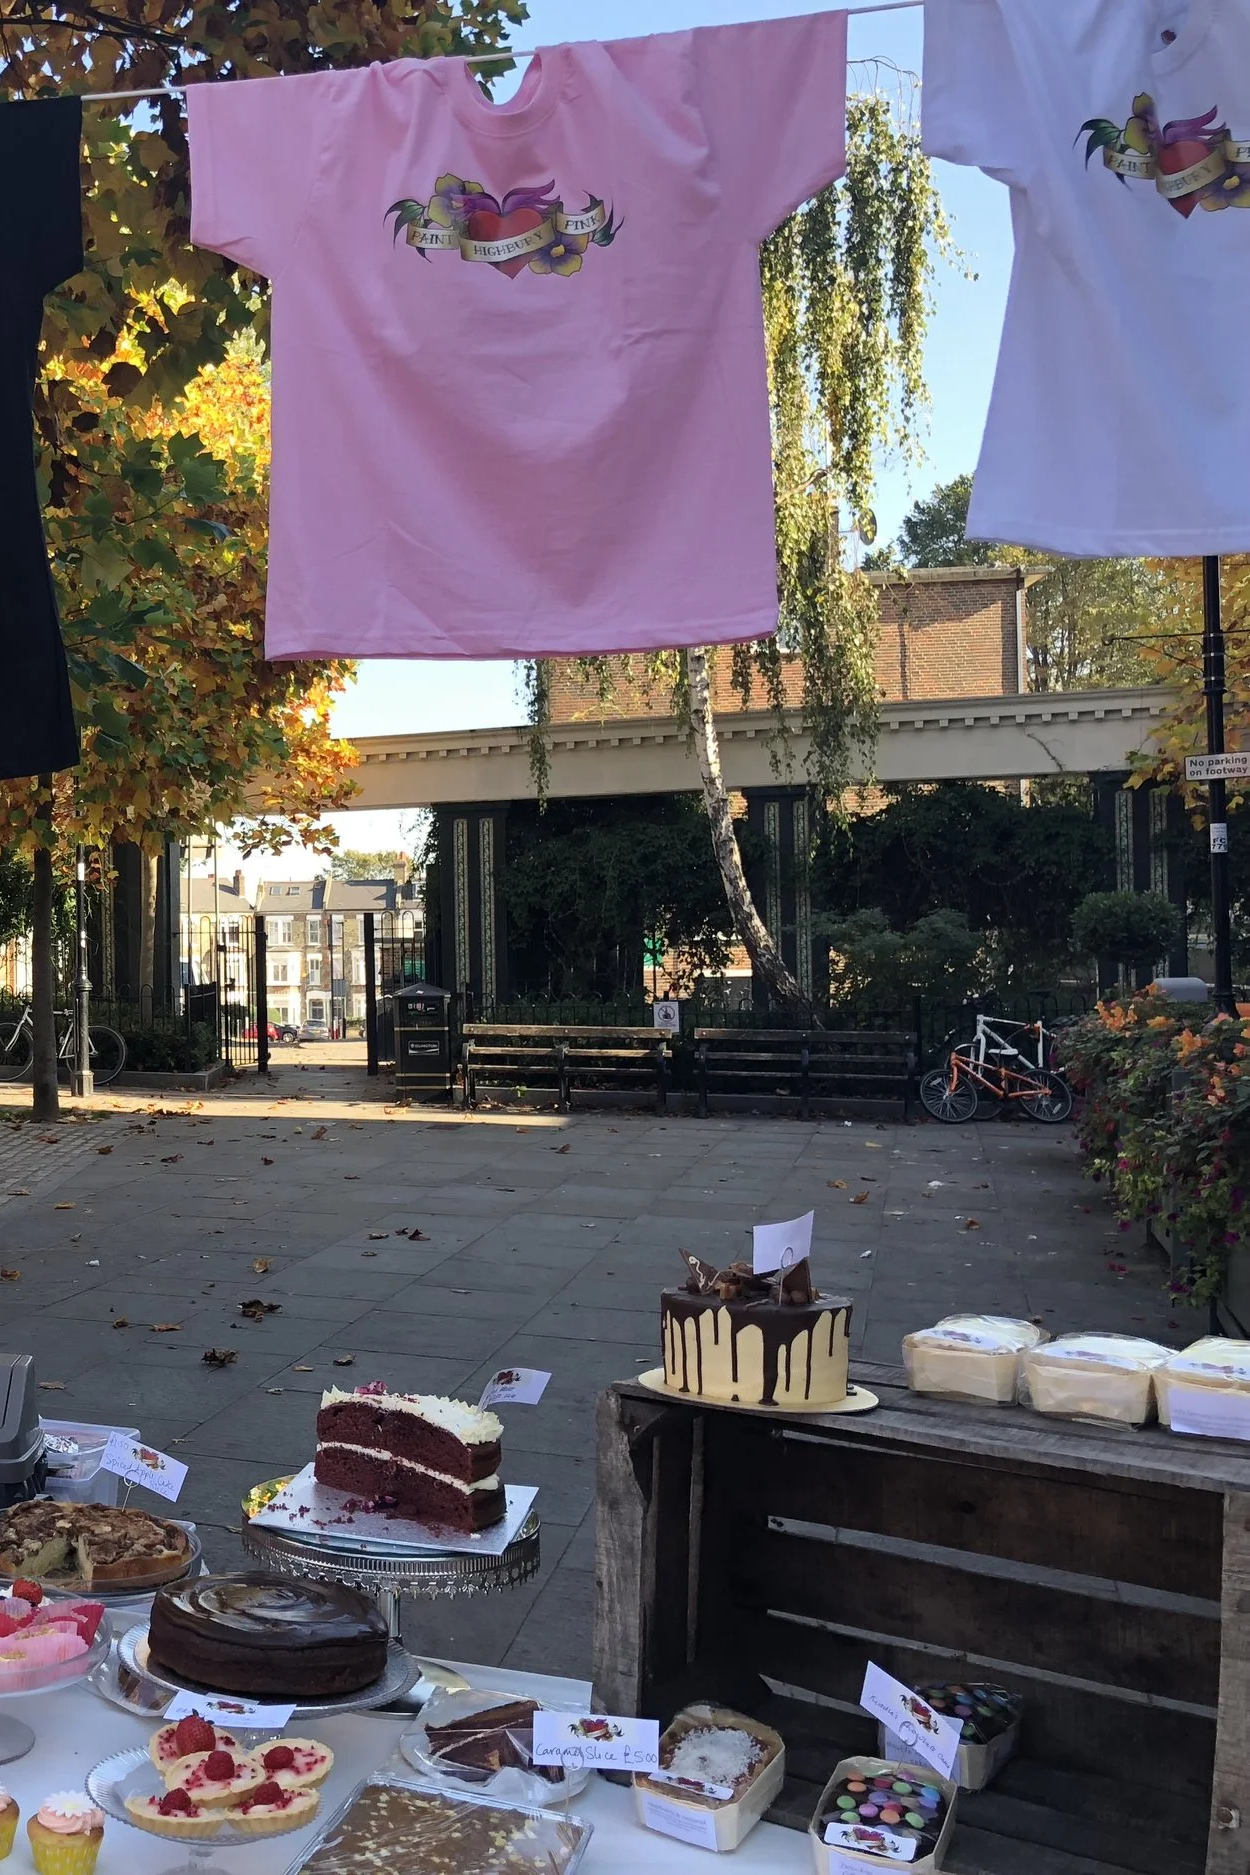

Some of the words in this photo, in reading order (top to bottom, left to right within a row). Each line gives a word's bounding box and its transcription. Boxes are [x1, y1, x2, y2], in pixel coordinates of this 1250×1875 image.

[411, 229, 453, 246] PAINT
[473, 230, 544, 257] HIGHBURY
[564, 216, 599, 231] PINK
[1190, 760, 1205, 768] No
[1208, 756, 1248, 767] parking
[1190, 769, 1202, 777] on
[1206, 766, 1248, 776] footway
[535, 1743, 583, 1758] Caramel
[586, 1746, 618, 1762] Slice
